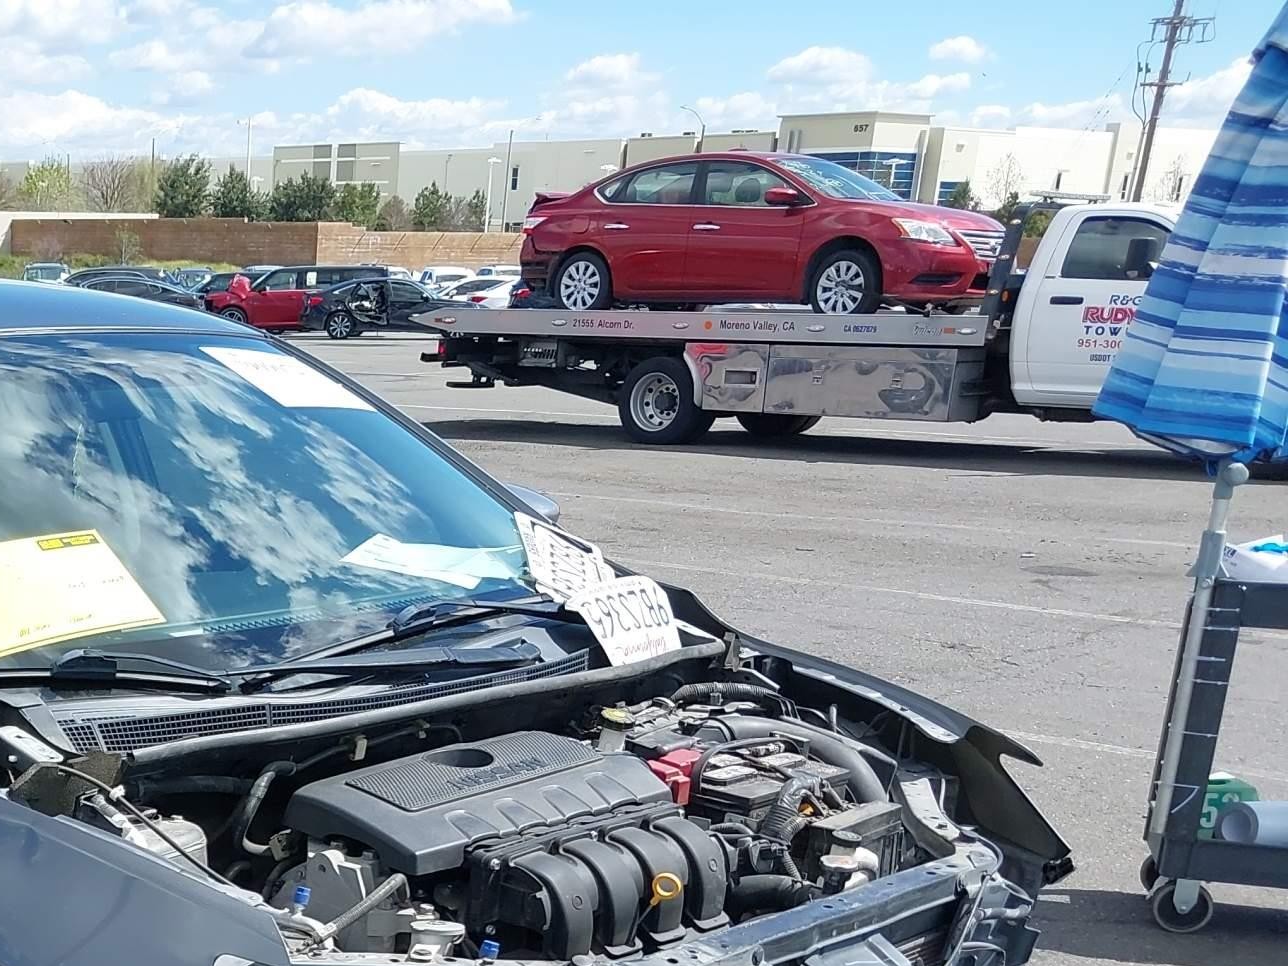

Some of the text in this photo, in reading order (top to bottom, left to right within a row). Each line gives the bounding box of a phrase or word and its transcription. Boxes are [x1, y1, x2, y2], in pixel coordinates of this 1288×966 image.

[597, 320, 622, 329] Alcorn
[623, 321, 634, 329] Dr.
[719, 320, 795, 332] Moreno Valley, CA
[843, 324, 852, 333] CA
[1083, 326, 1128, 337] TOW
[1089, 353, 1111, 362] USDOT
